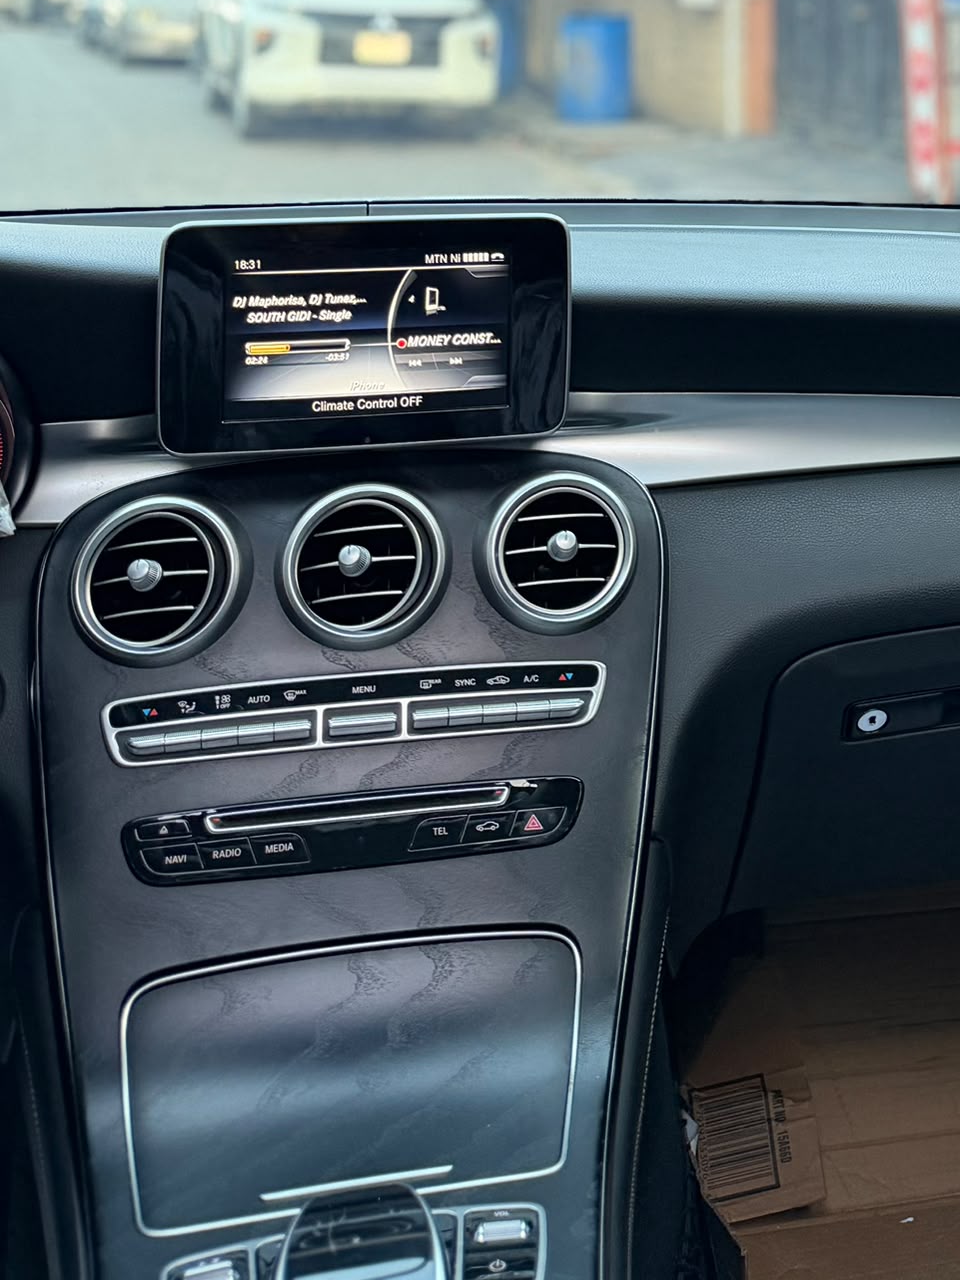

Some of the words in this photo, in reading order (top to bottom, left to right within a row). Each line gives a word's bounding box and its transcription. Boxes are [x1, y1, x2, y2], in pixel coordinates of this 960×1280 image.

[234, 259, 262, 270] 18:31
[424, 253, 448, 264] MTN
[450, 253, 461, 263] Ni
[232, 296, 248, 308] DJ
[248, 294, 307, 308] Maphorisa,
[309, 294, 323, 306] DJ
[246, 311, 287, 324] SOUTH
[287, 310, 312, 323] GIDI
[318, 308, 353, 323] Single
[407, 334, 451, 348] MONEY
[350, 380, 386, 392] iPhone
[312, 399, 354, 412] Climate
[356, 396, 398, 410] Control
[400, 395, 423, 408] OFF
[454, 677, 477, 688] SYNC
[523, 674, 540, 683] A/C
[351, 683, 377, 695] MENU
[247, 694, 271, 705] AUTO
[432, 825, 449, 837] TEL
[211, 846, 242, 860] RADIO
[264, 841, 295, 855] MEDIA
[164, 853, 188, 866] NAVI
[771, 1089, 785, 1109] PART
